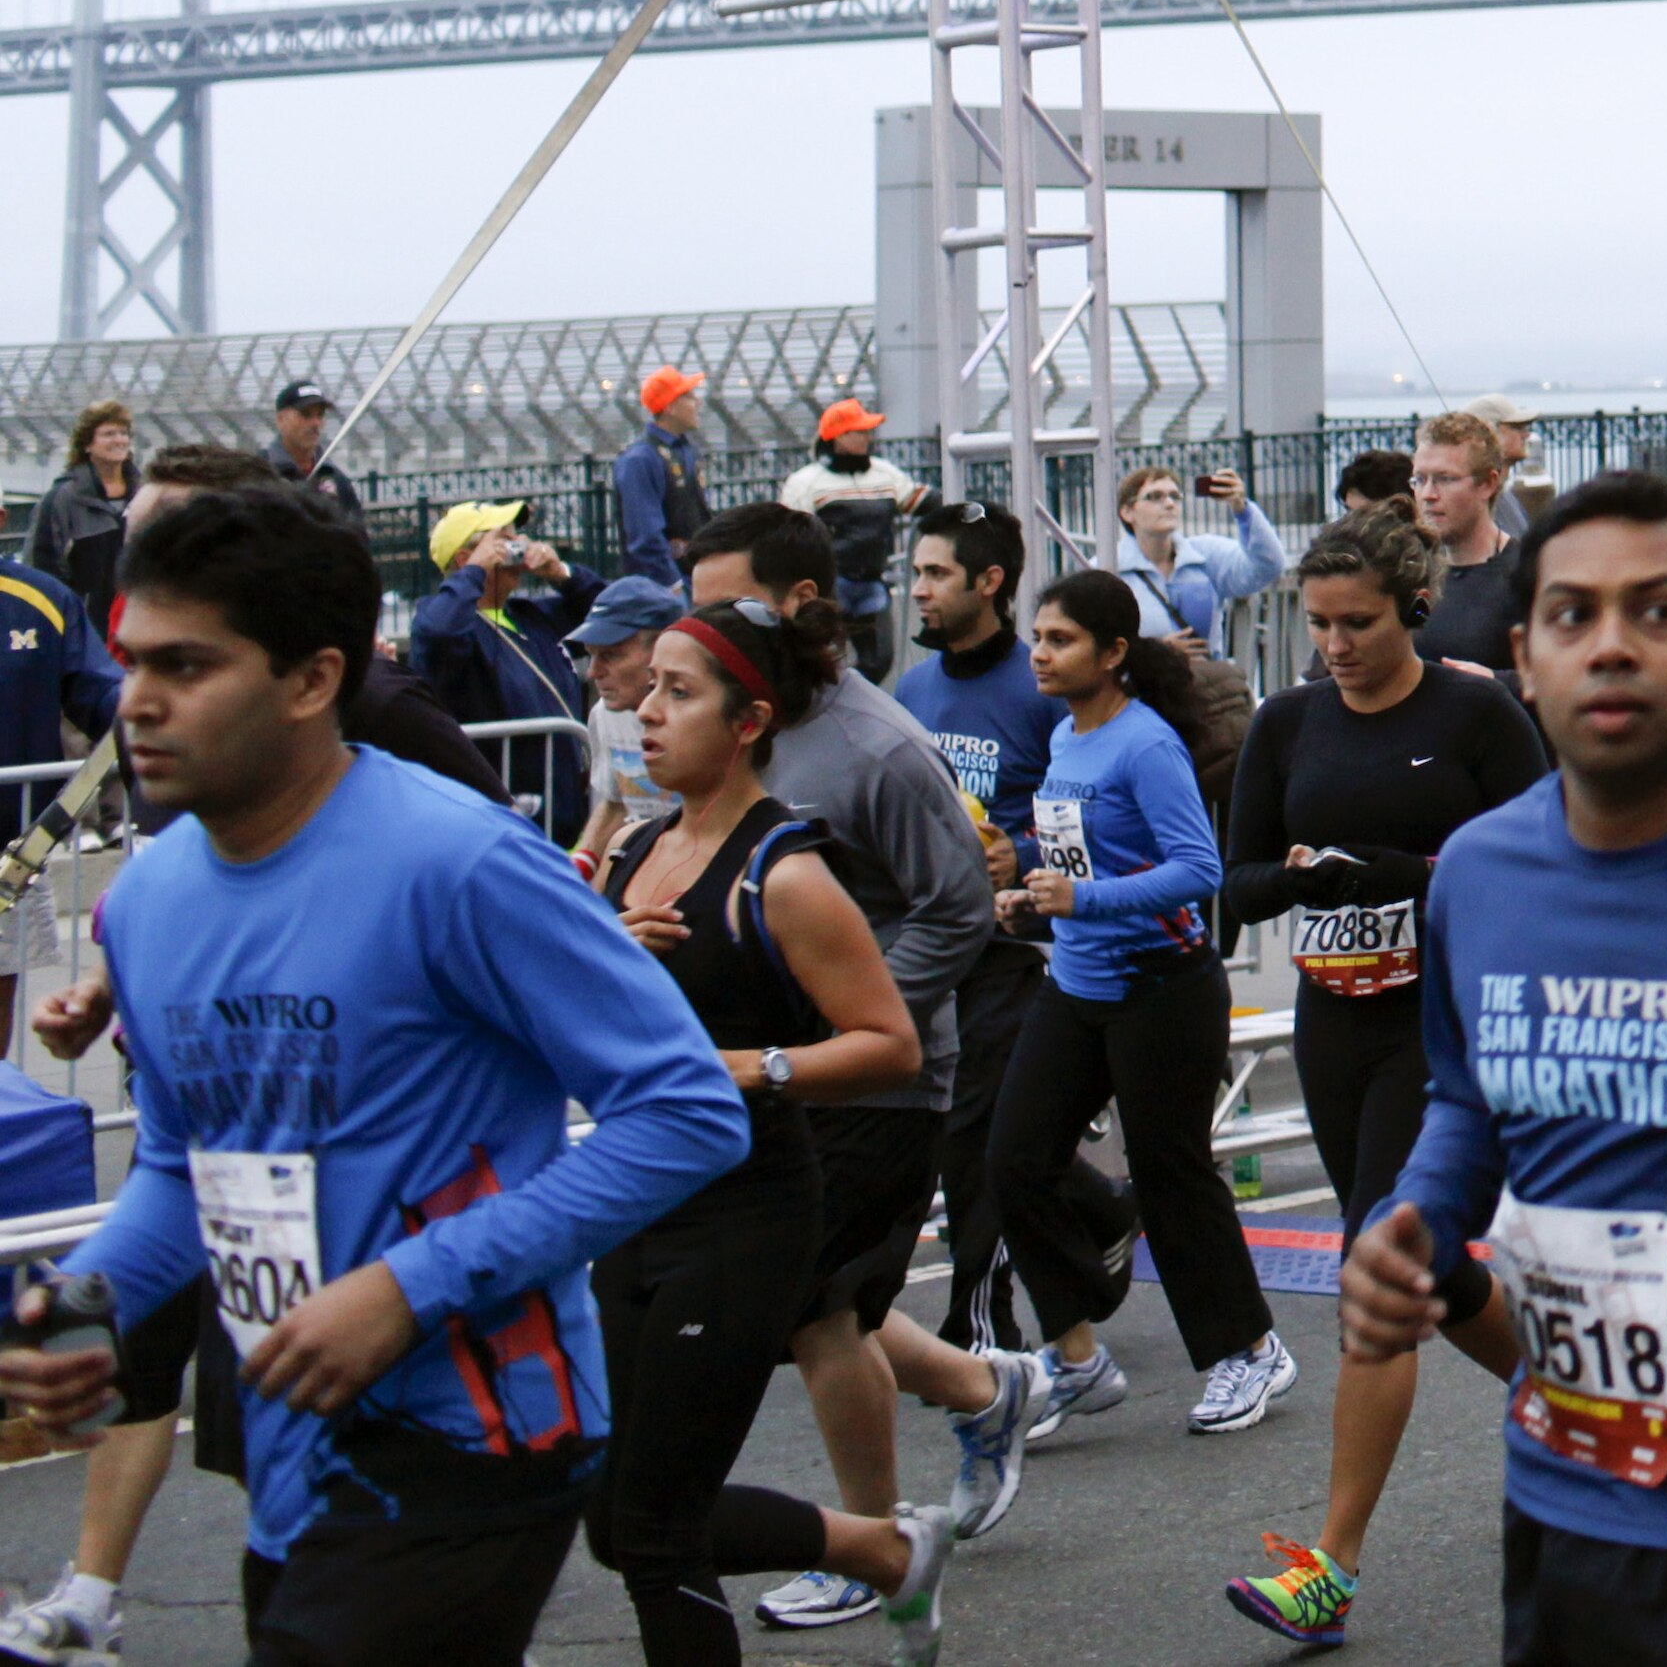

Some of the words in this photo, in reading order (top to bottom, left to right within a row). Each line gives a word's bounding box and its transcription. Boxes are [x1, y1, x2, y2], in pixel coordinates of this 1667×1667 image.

[1068, 134, 1141, 163] PER
[1155, 136, 1185, 164] 14
[9, 628, 39, 650] M
[943, 749, 999, 773] NCISCO
[1300, 907, 1408, 952] 70887
[1480, 974, 1527, 1013] THE
[1477, 1015, 1532, 1053] SAN
[1519, 1299, 1666, 1398] 0518
